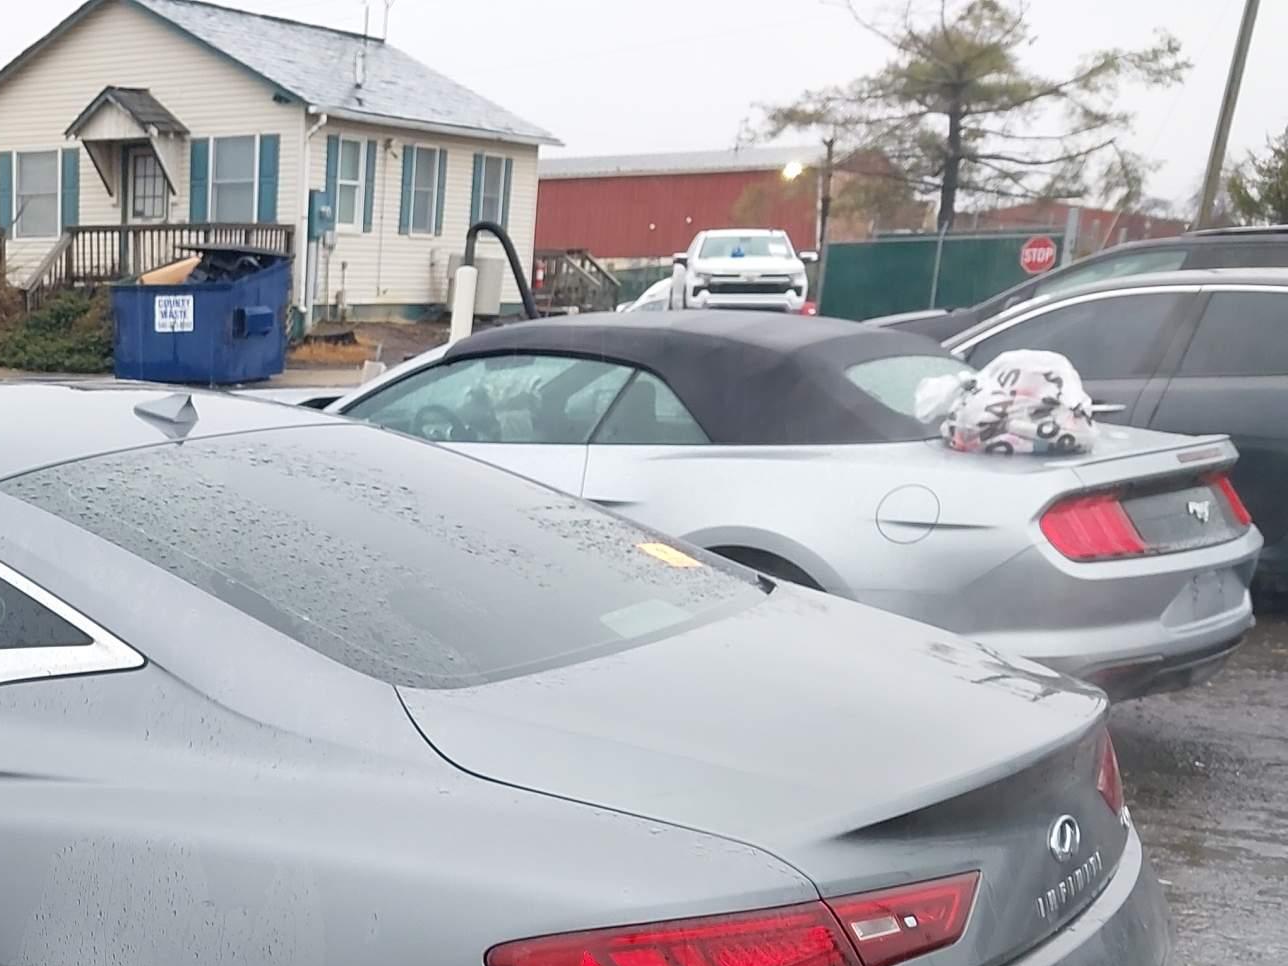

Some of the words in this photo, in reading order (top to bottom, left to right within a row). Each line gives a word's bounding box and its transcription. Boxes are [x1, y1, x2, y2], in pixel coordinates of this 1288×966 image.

[1023, 247, 1053, 263] STOP
[158, 298, 190, 308] COUNTY
[160, 310, 187, 320] WASTE
[1036, 850, 1103, 918] INFINITI
